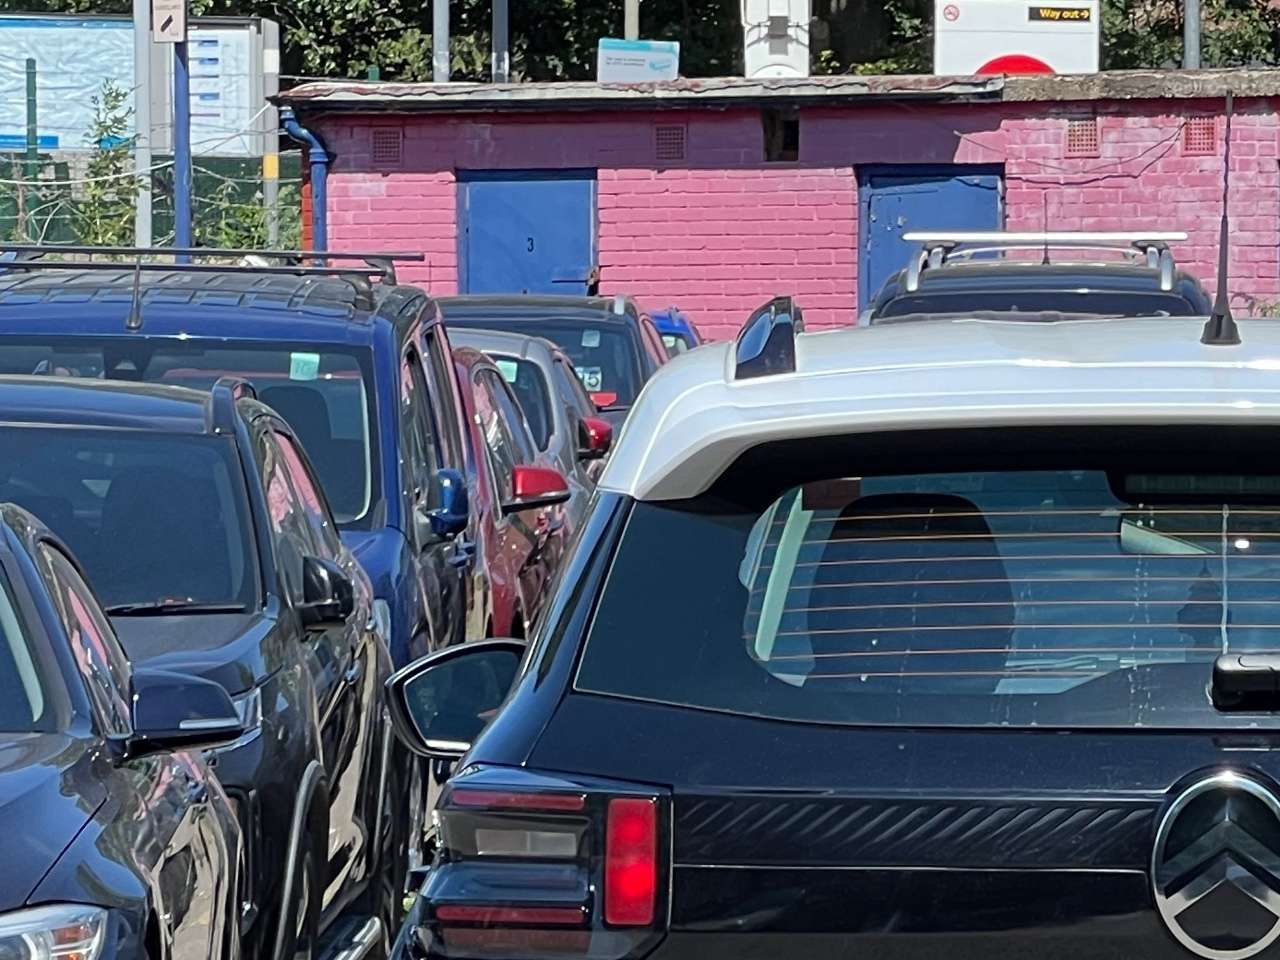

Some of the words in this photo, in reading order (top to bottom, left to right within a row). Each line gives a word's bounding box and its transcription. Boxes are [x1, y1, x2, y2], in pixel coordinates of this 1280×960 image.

[1040, 8, 1061, 20] Way
[1062, 10, 1079, 19] out
[527, 237, 534, 252] 3
